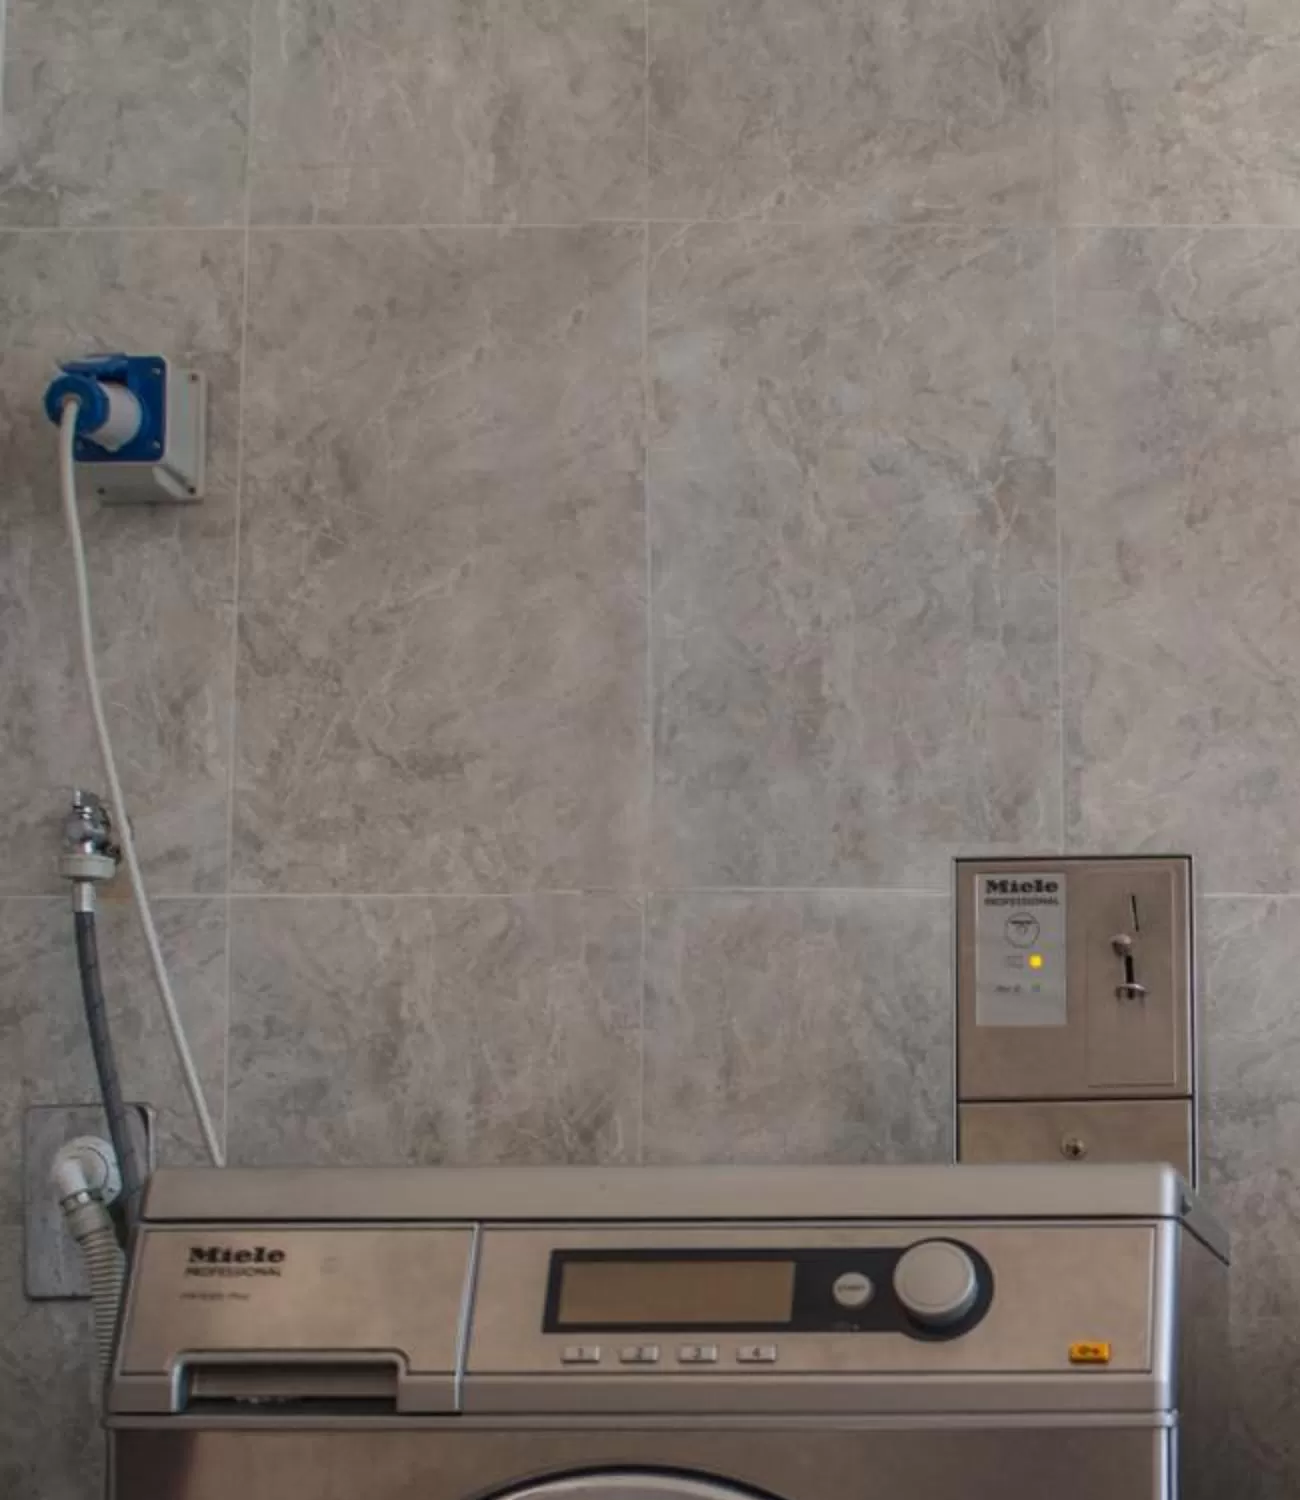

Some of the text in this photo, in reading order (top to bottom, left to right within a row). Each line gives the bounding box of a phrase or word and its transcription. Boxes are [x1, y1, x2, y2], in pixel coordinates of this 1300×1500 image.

[985, 879, 1059, 893] Miele
[188, 1246, 286, 1264] Miele
[184, 1267, 282, 1277] PROFESSIONAL
